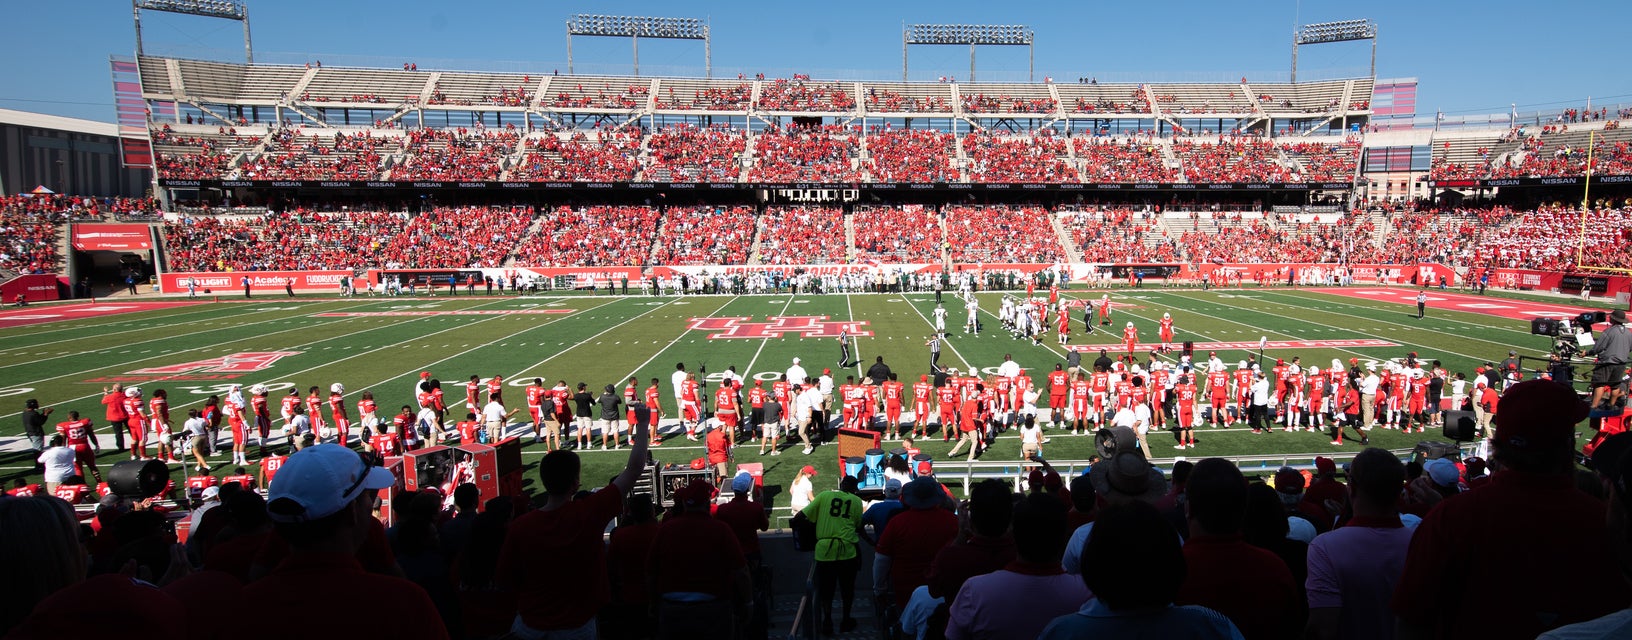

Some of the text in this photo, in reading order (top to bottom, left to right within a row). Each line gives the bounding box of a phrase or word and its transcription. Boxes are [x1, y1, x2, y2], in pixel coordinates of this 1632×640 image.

[178, 278, 229, 286] BD LIGHT
[1018, 378, 1026, 390] 41
[1054, 375, 1064, 386] 56
[1097, 377, 1107, 388] 87
[1214, 377, 1225, 387] 90
[888, 388, 897, 398] 51
[916, 388, 926, 398] 97
[1076, 386, 1088, 396] 28
[1182, 390, 1192, 400] 38
[718, 394, 729, 406] 53
[750, 394, 761, 404] 39
[68, 428, 86, 440] 82
[379, 440, 394, 454] 14
[267, 459, 281, 471] 81
[830, 497, 852, 519] 81
